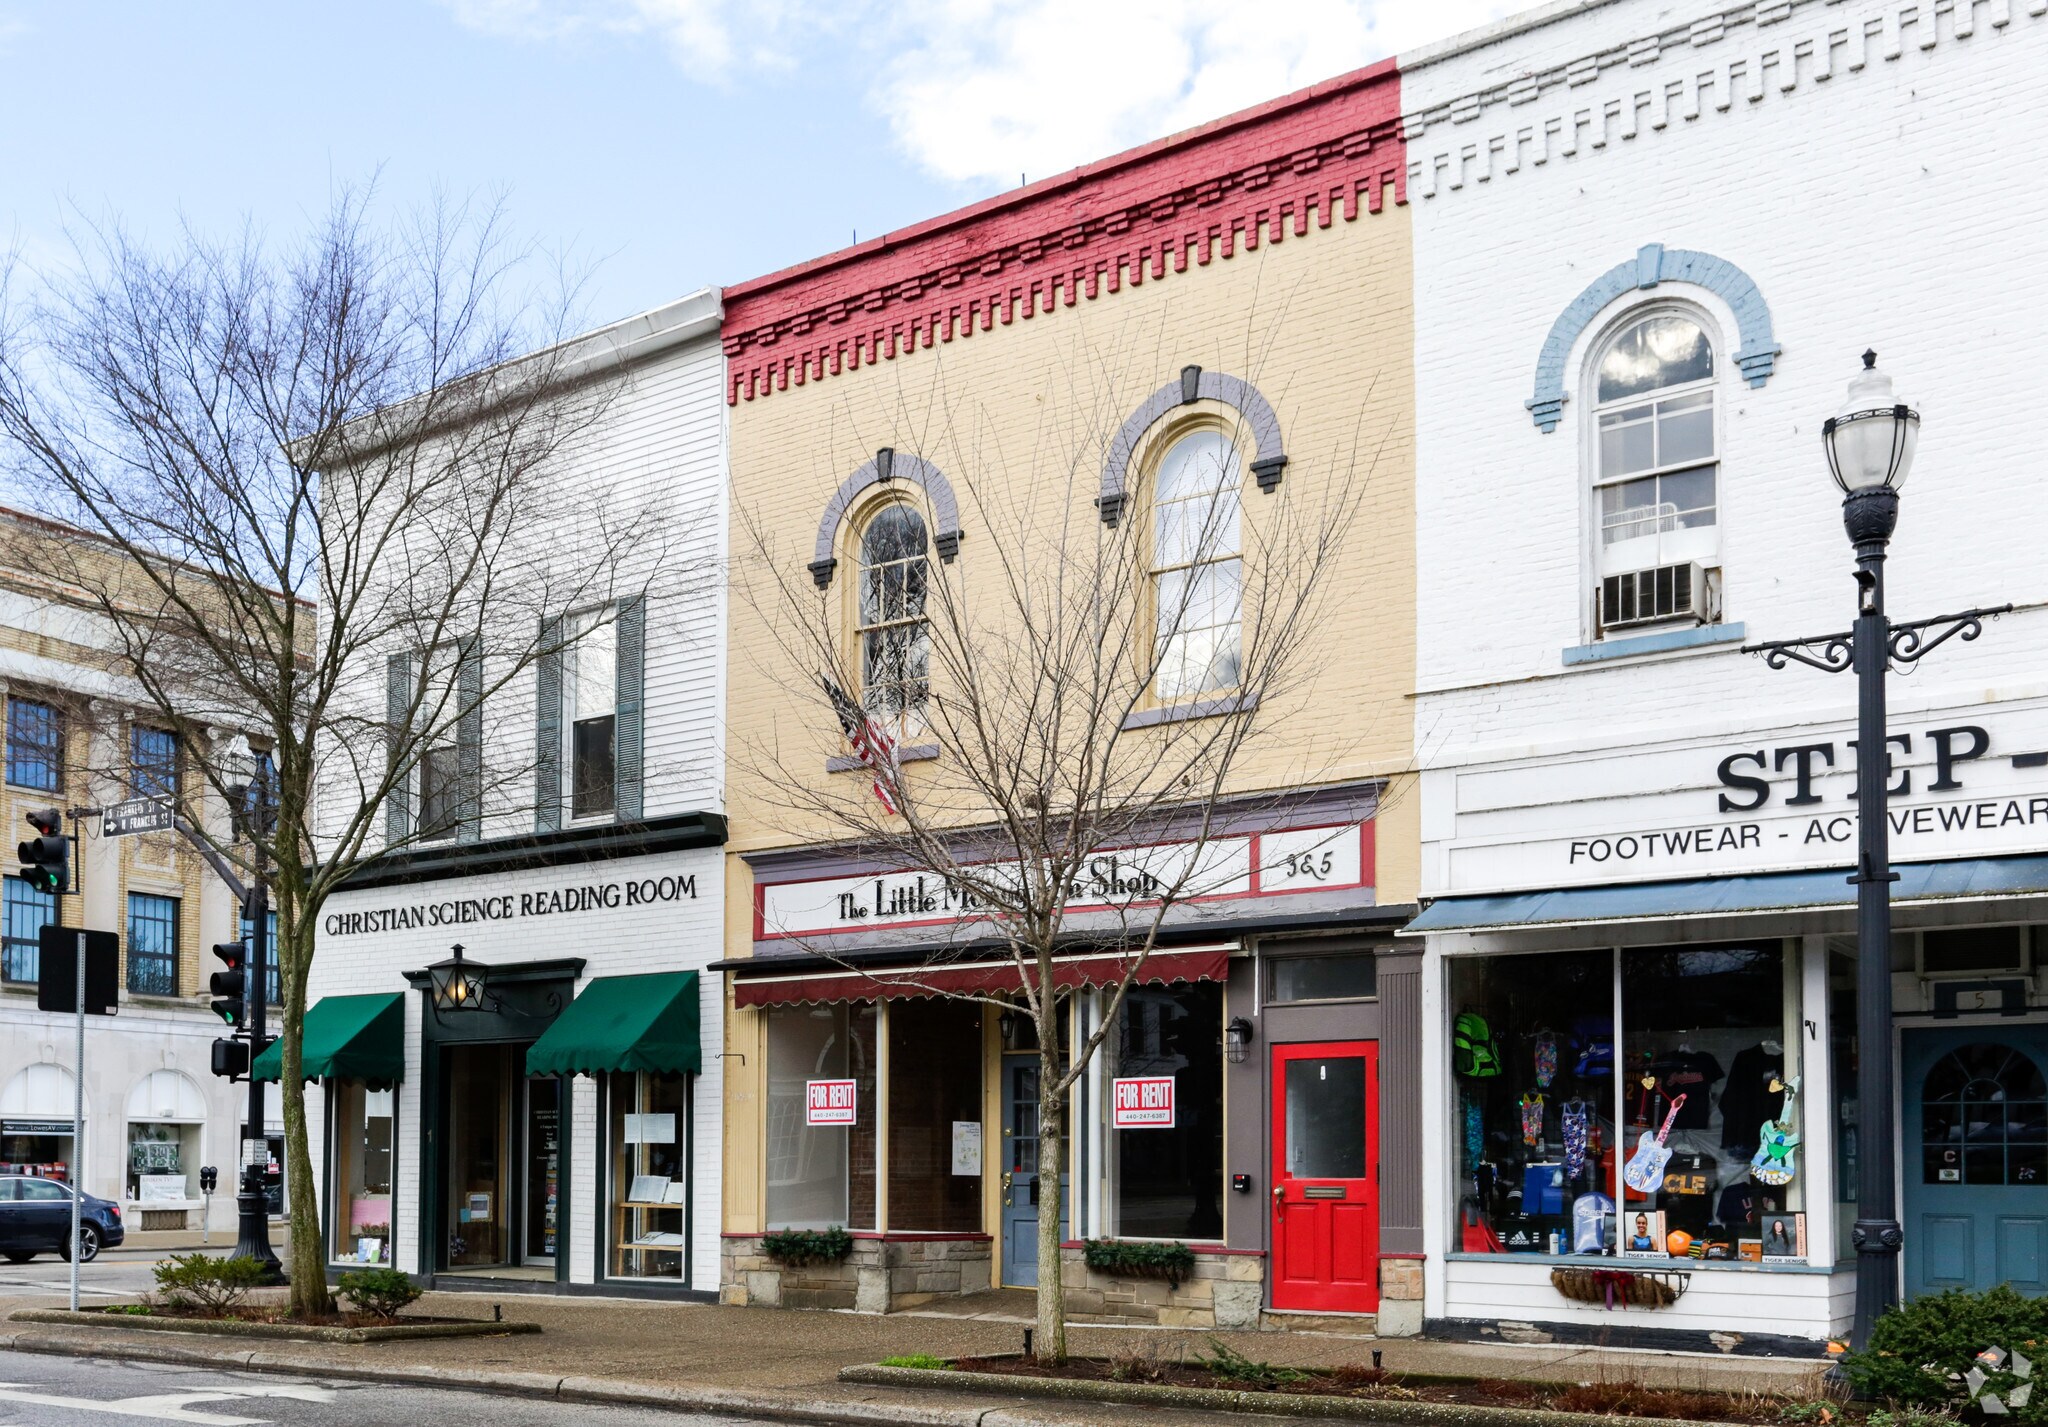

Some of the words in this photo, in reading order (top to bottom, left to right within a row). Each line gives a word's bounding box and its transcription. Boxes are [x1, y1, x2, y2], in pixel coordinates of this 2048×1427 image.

[121, 819, 126, 830] N
[130, 814, 157, 829] FRANKLIN
[1569, 824, 1761, 865] FOOTWEAR
[1804, 797, 2048, 845] ACVEWEAR
[837, 892, 868, 920] The
[874, 875, 937, 916] Little
[1090, 855, 1159, 899] Shop
[325, 905, 425, 936] CHRISTIAN
[428, 895, 513, 927] SCIENCE
[520, 884, 621, 917] READING
[625, 874, 697, 907] ROOM
[810, 1084, 828, 1108] FOR
[829, 1084, 853, 1107] RENT
[1117, 1083, 1139, 1108] FOR
[1141, 1082, 1171, 1107] RENT
[1663, 1173, 1706, 1195] CLE
